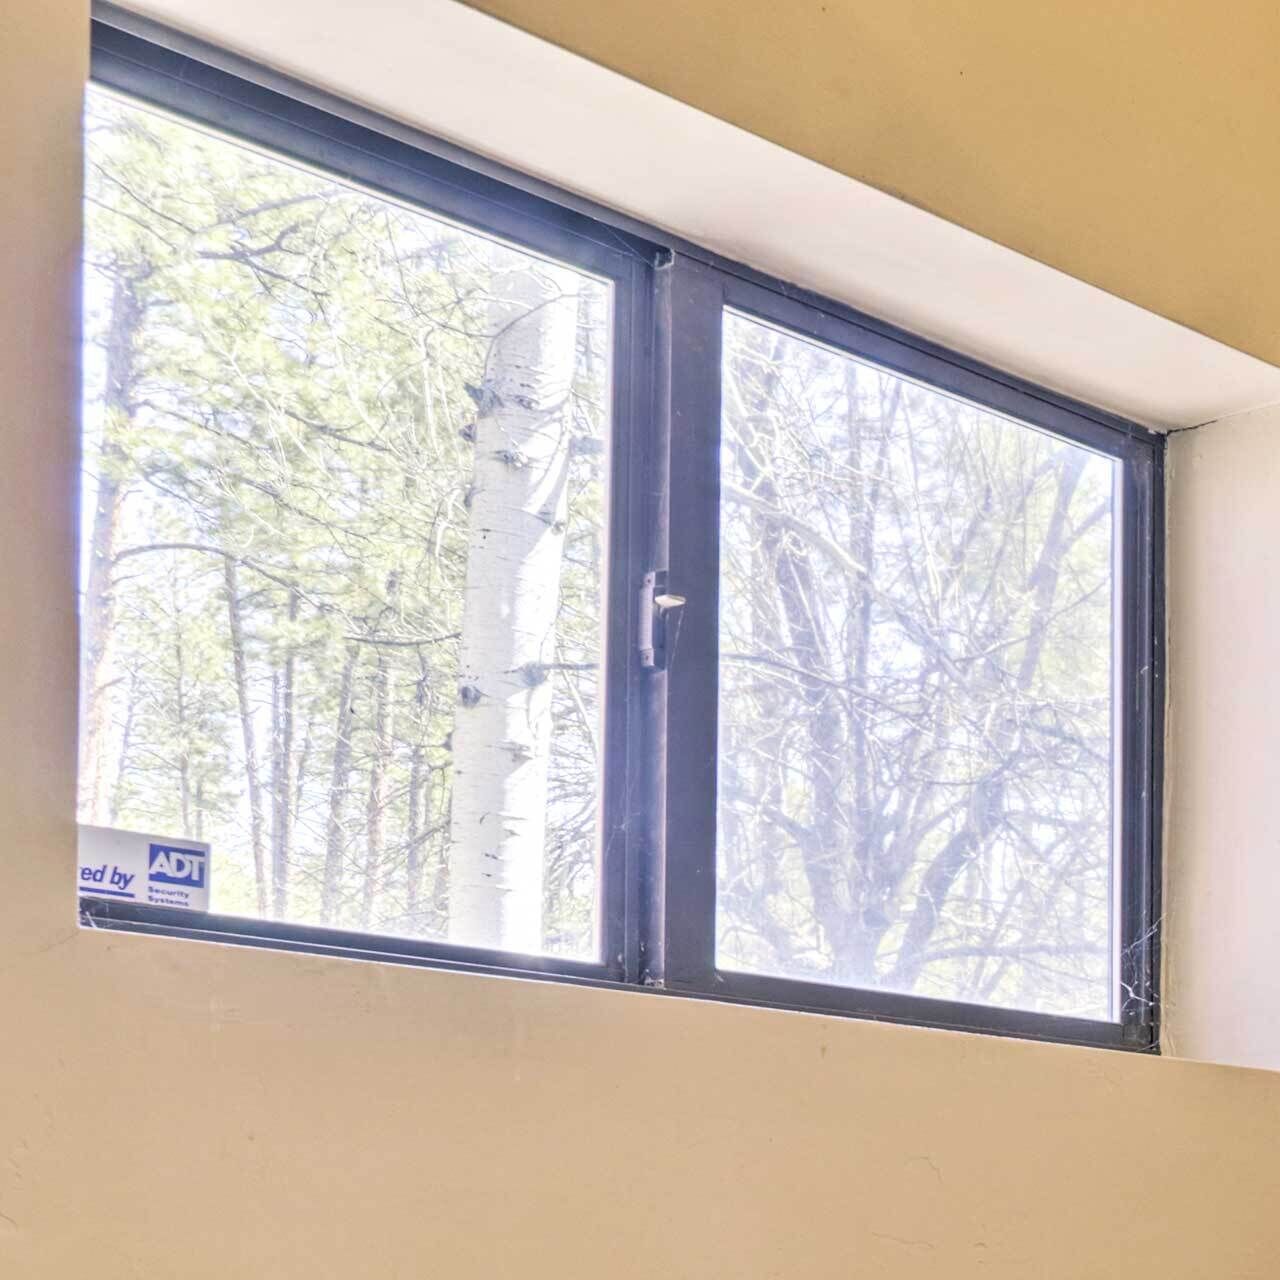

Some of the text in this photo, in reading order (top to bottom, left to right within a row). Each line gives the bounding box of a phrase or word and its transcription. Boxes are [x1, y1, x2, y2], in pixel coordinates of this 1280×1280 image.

[150, 851, 206, 881] ADT
[80, 864, 135, 890] ed by
[148, 886, 190, 899] Security
[148, 895, 190, 907] Systems
